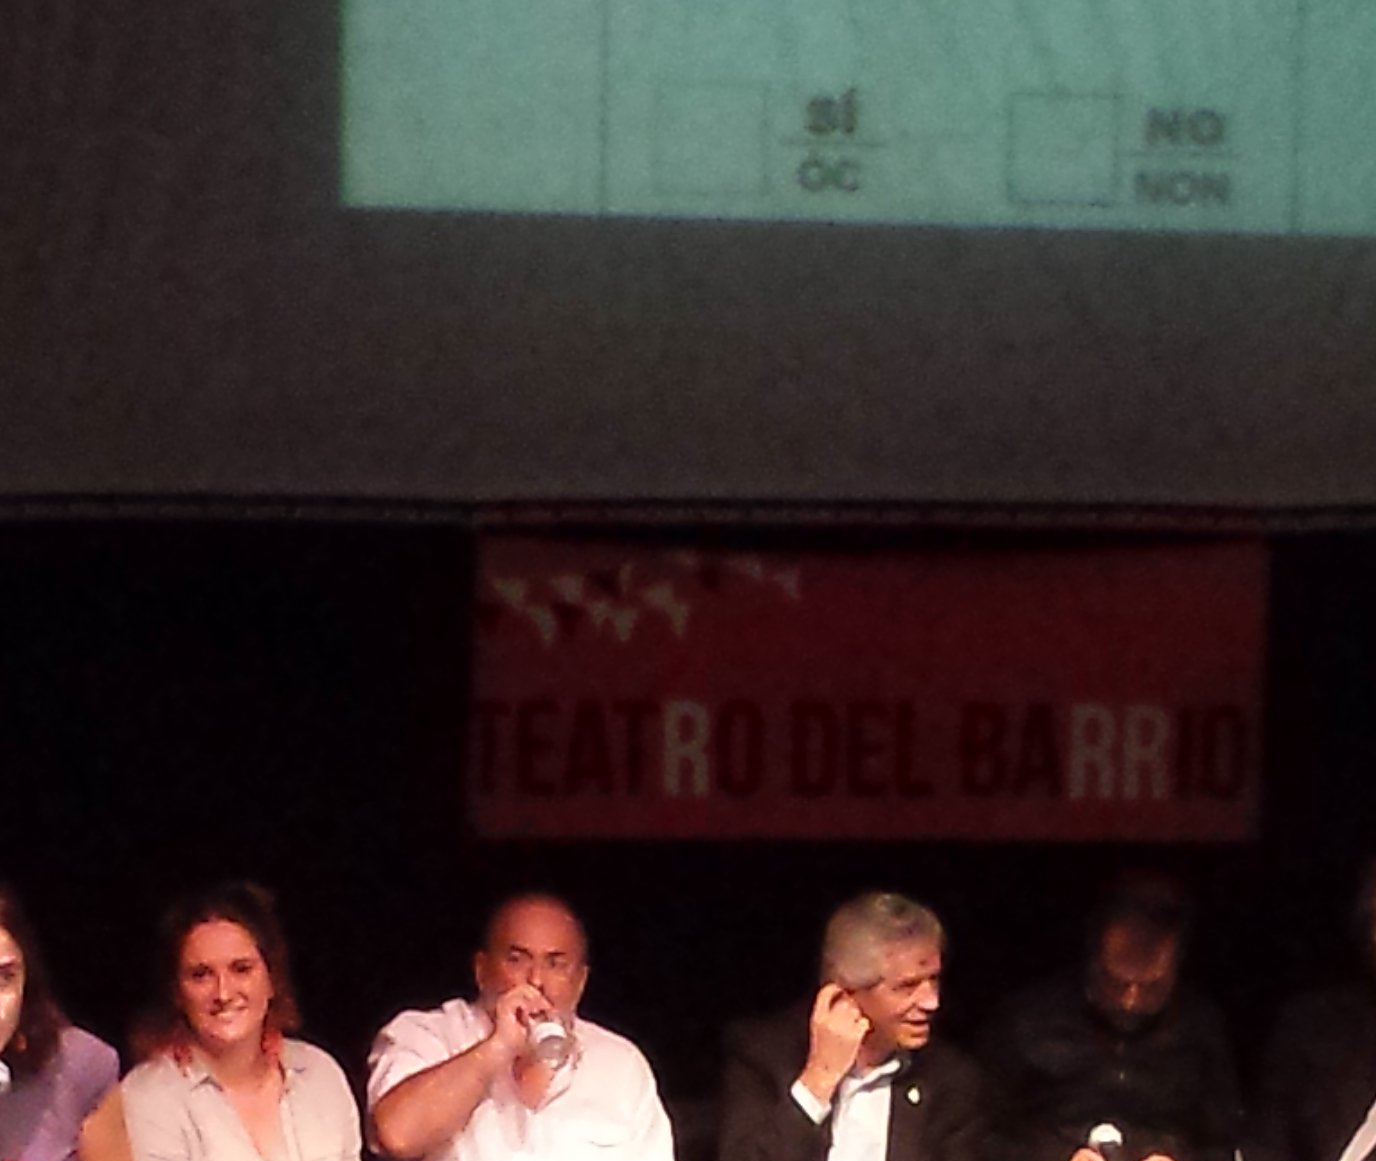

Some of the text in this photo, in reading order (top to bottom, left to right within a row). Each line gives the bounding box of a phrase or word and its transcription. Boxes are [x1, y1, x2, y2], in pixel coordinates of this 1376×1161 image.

[1145, 106, 1224, 145] NO
[1135, 171, 1230, 206] NON
[473, 698, 1248, 800] TEATRO DEL BARRIO
